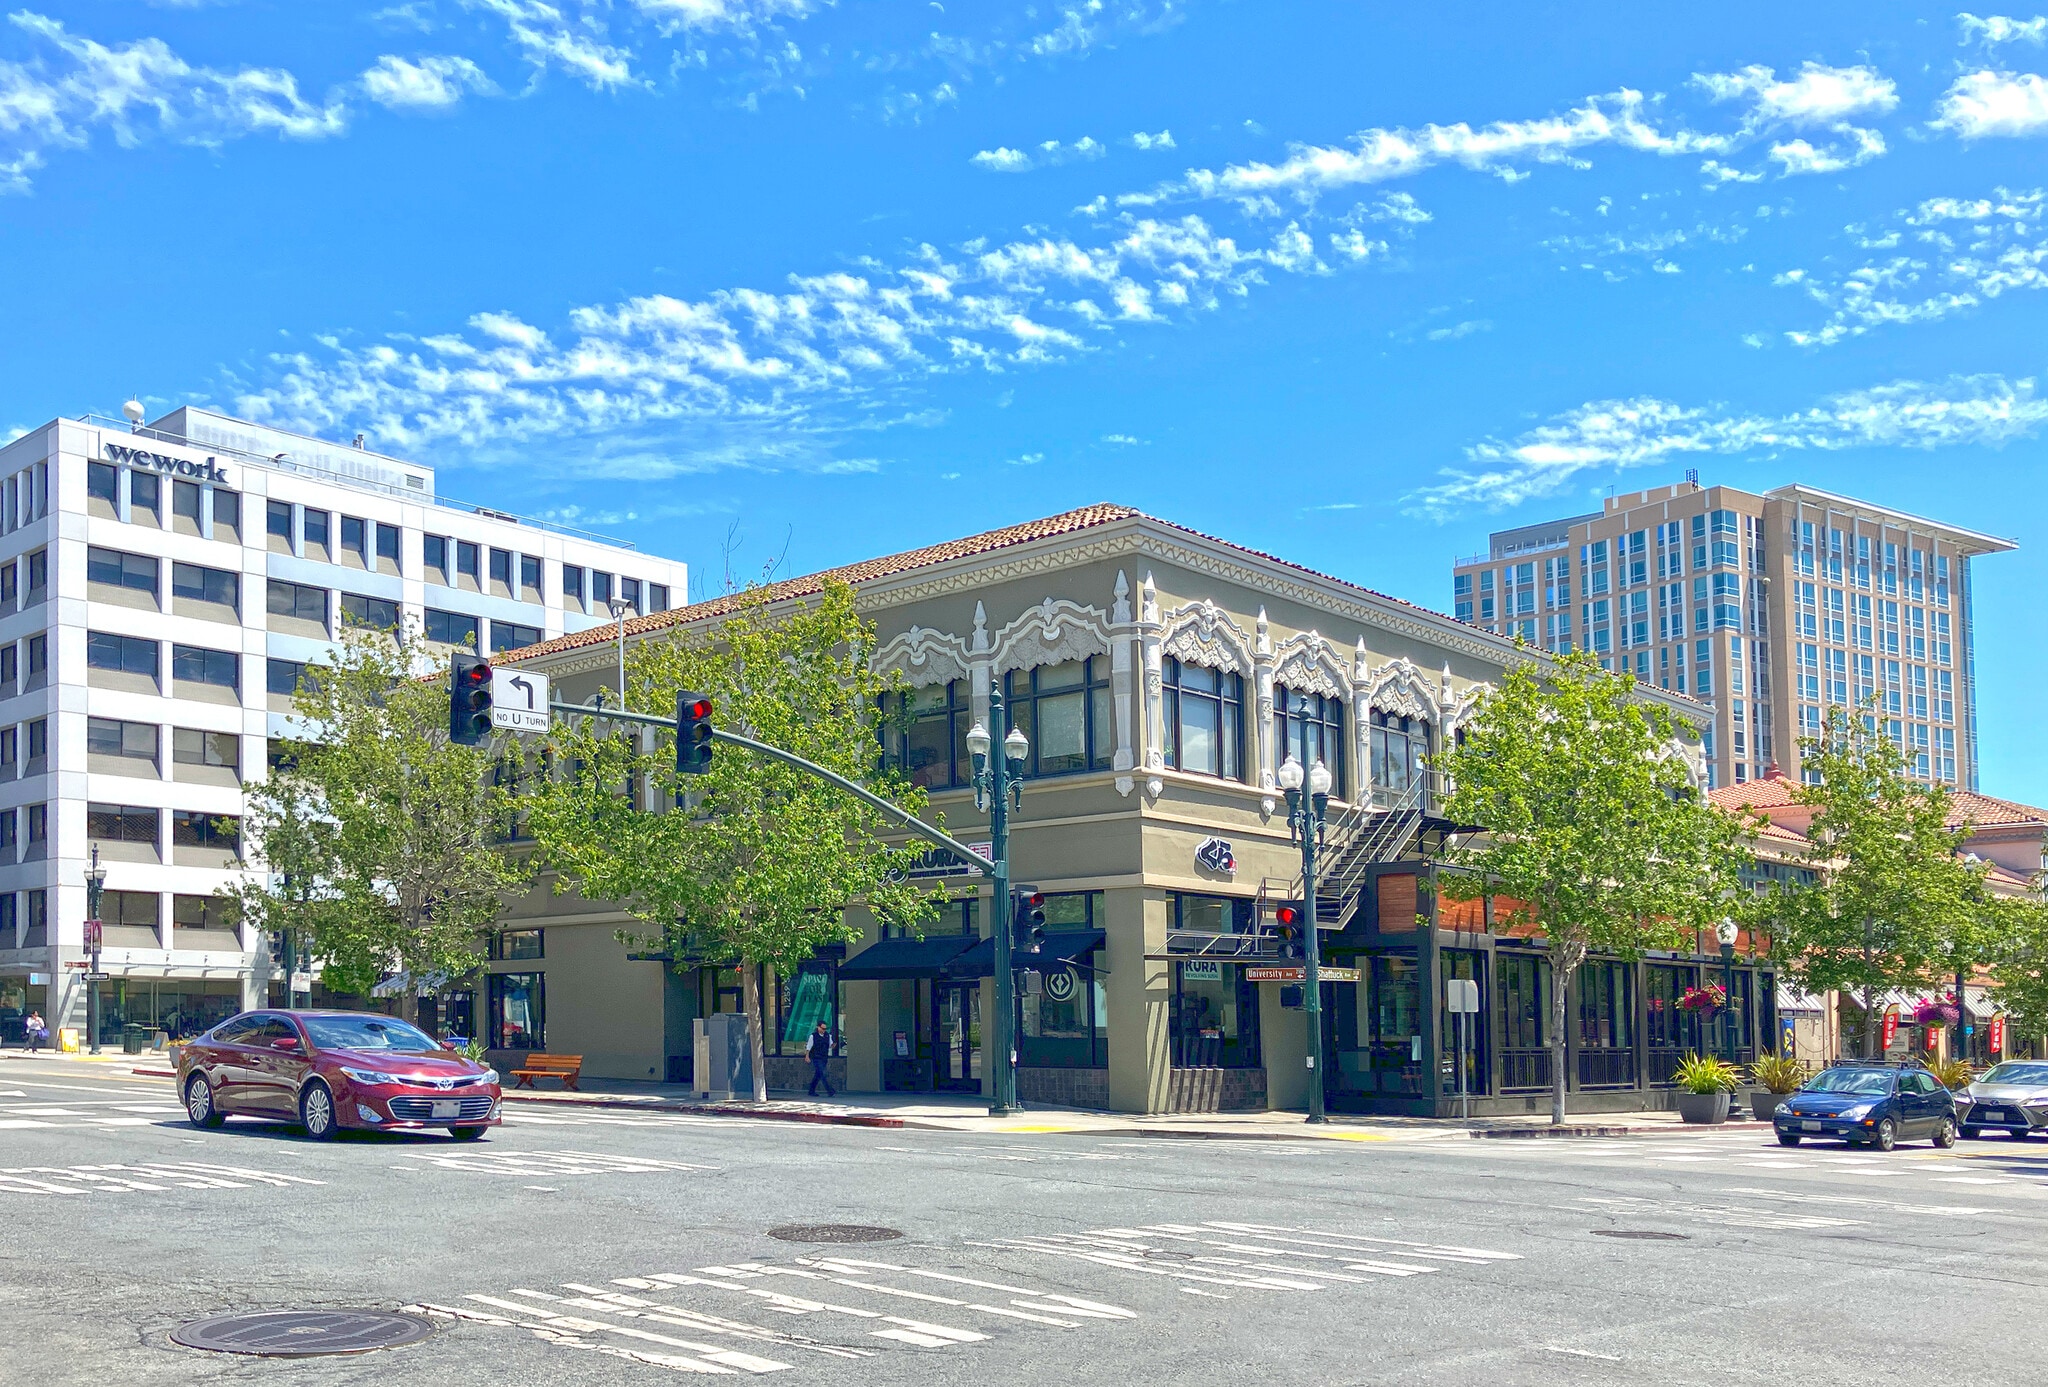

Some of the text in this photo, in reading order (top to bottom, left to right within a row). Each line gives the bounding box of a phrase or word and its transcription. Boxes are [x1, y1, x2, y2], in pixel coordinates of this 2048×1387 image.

[104, 442, 229, 484] wework
[496, 712, 547, 727] NO U TURN
[1185, 961, 1218, 973] KURA
[1247, 969, 1283, 979] University
[1318, 969, 1344, 980] Shattuck
[1886, 1015, 1895, 1046] OPEN
